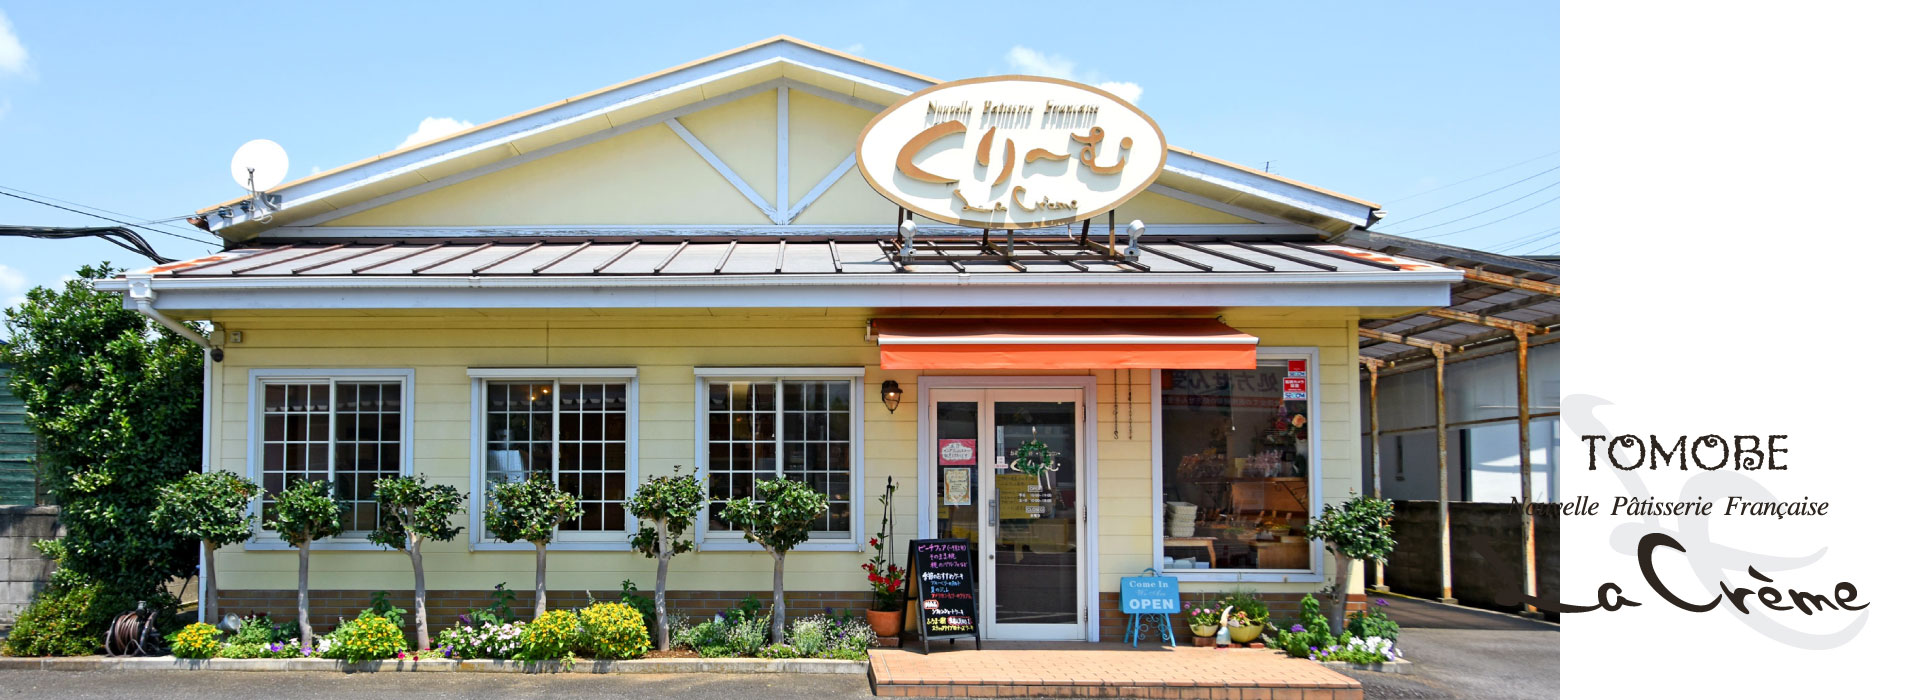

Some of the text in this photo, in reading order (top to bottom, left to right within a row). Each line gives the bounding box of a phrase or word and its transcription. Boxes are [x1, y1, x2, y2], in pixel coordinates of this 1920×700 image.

[896, 120, 1133, 187] くりーむ
[953, 188, 1007, 213] La
[1129, 598, 1174, 610] OPEN
